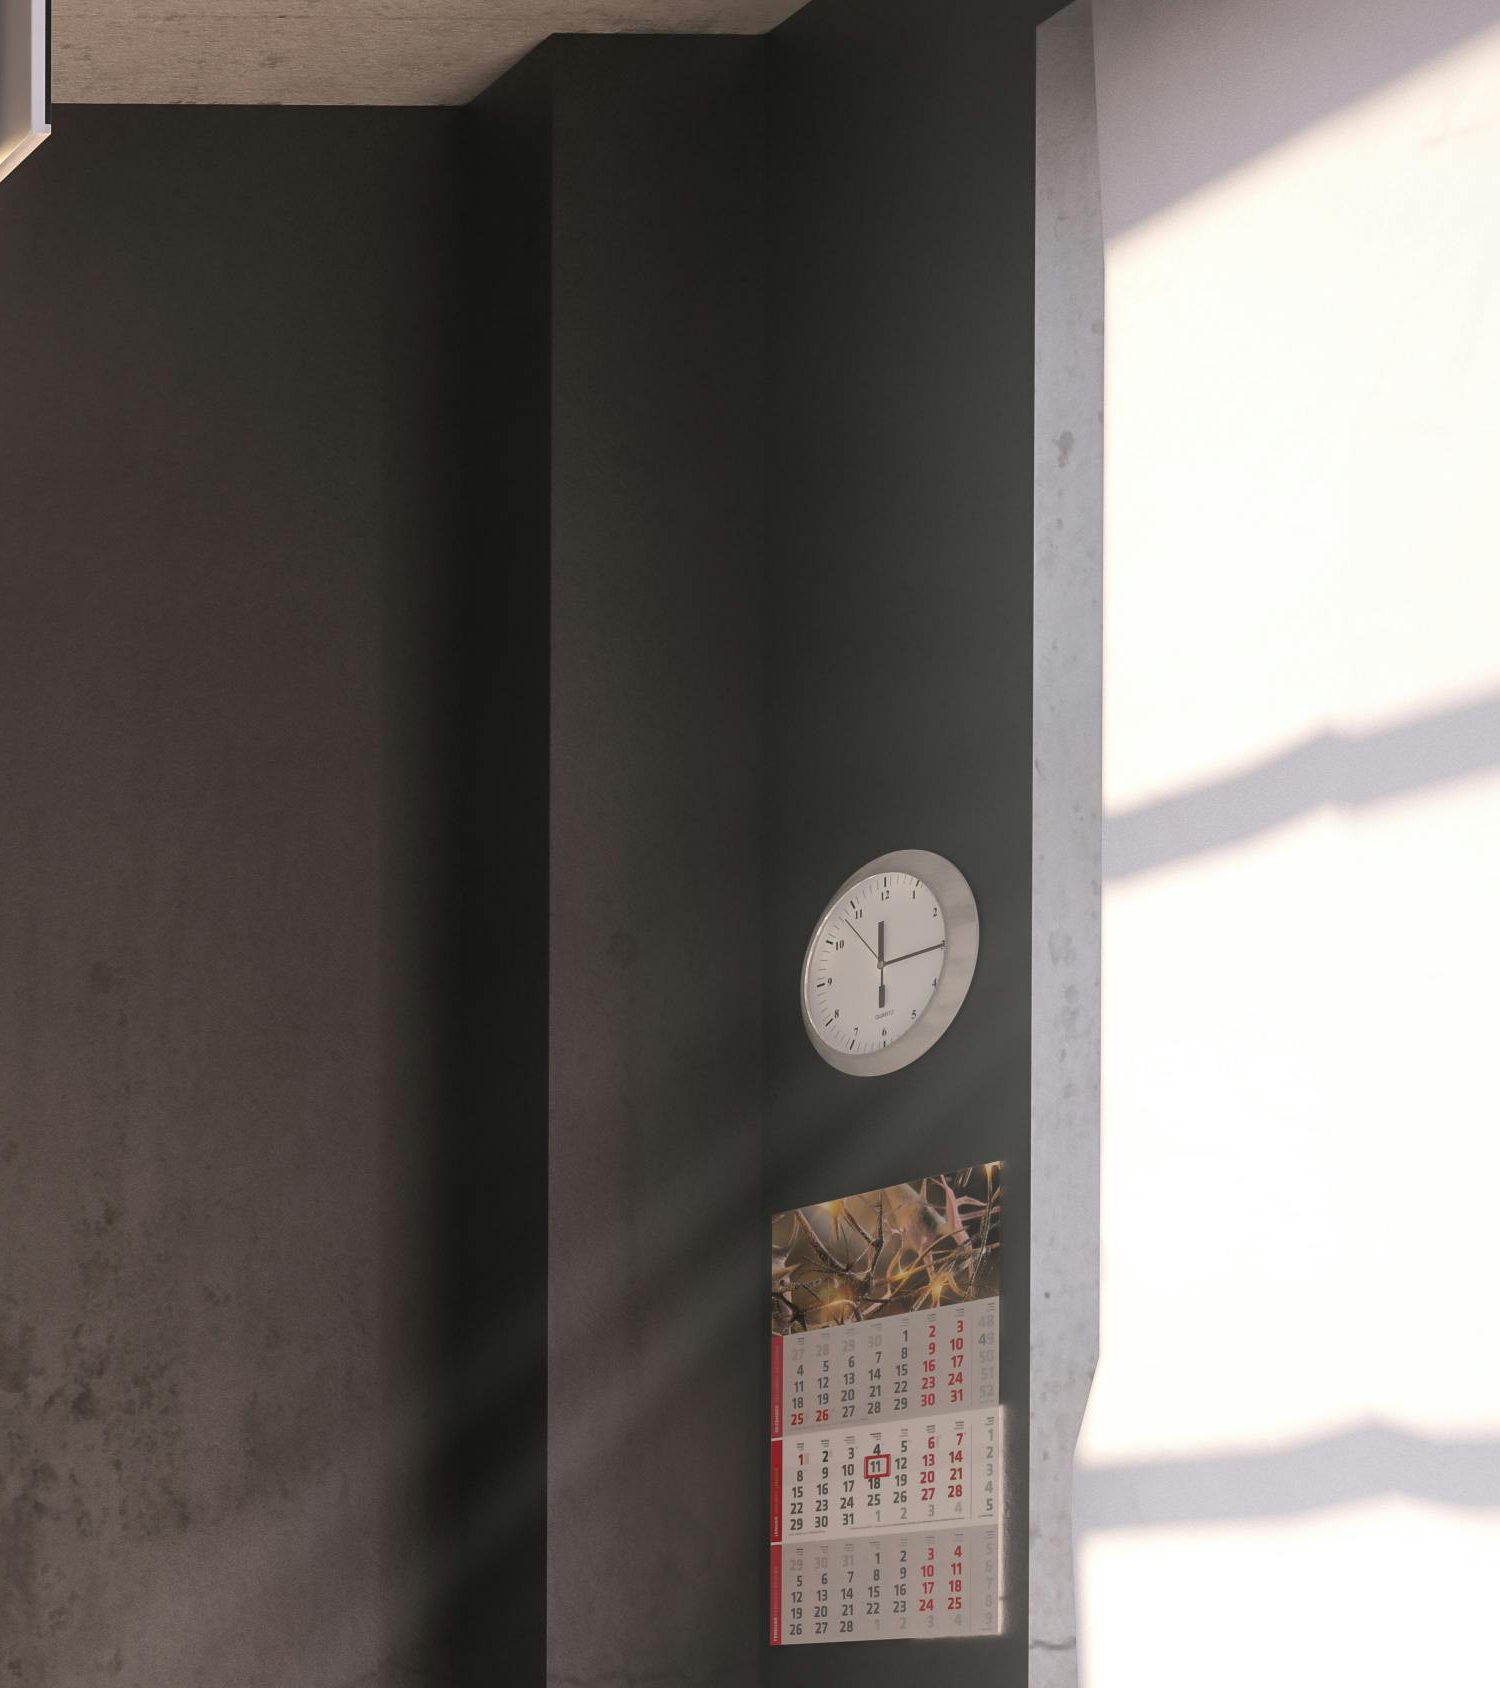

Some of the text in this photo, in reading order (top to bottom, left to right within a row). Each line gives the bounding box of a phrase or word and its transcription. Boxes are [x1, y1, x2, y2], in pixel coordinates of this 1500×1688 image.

[881, 889, 890, 901] 12
[855, 909, 862, 920] 11
[932, 907, 938, 918] 2
[836, 940, 845, 951] 10
[827, 977, 833, 986] 9
[834, 1009, 840, 1019] 8
[911, 1009, 917, 1020] 5
[853, 1027, 859, 1036] 7
[881, 1028, 887, 1037] 6
[903, 1329, 908, 1342] 1
[929, 1325, 936, 1338] 2
[957, 1320, 964, 1333] 3
[796, 1364, 804, 1376] 4
[823, 1360, 829, 1372] 5
[848, 1355, 855, 1368] 6
[875, 1351, 882, 1364] 7
[901, 1347, 908, 1359] 8
[928, 1342, 936, 1355] 9
[950, 1337, 963, 1351] 10
[793, 1380, 804, 1393] 11
[817, 1376, 829, 1389] 12
[843, 1372, 855, 1385] 13
[868, 1368, 881, 1381] 14
[895, 1364, 908, 1377] 15
[923, 1359, 936, 1372] 16
[951, 1354, 964, 1368] 17
[791, 1396, 804, 1409] 18
[817, 1393, 829, 1406] 19
[840, 1388, 855, 1402] 20
[869, 1385, 881, 1398] 21
[894, 1380, 908, 1394] 22
[921, 1376, 935, 1390] 23
[948, 1371, 963, 1386] 24
[791, 1413, 804, 1426] 25
[816, 1409, 829, 1422] 26
[842, 1405, 855, 1418] 27
[867, 1401, 881, 1415] 28
[894, 1397, 908, 1411] 29
[921, 1393, 935, 1407] 30
[950, 1389, 963, 1403] 31
[798, 1428, 994, 1466] 1 2 3 4 5 6 7 1
[797, 1446, 993, 1482] 8 9 10 11 12 13 14 2
[792, 1463, 993, 1498] 15 16 17 18 19 20 21 3
[790, 1480, 994, 1515] 22 23 24 25 26 27 28 4
[790, 1518, 803, 1531] 29
[815, 1515, 828, 1528] 30
[842, 1513, 854, 1526] 31
[875, 1510, 880, 1522] 1
[900, 1507, 907, 1520] 2
[928, 1504, 935, 1517] 3
[954, 1501, 963, 1513] 4
[986, 1498, 993, 1511] 5
[875, 1552, 880, 1565] 1
[900, 1550, 907, 1562] 2
[928, 1547, 934, 1561] 3
[954, 1545, 962, 1558] 4
[797, 1575, 803, 1587] 5
[821, 1573, 828, 1585] 6
[847, 1571, 854, 1583] 7
[873, 1569, 880, 1581] 8
[900, 1566, 907, 1579] 9
[920, 1564, 934, 1577] 10
[951, 1562, 962, 1576] 11
[791, 1591, 803, 1603] 12
[816, 1589, 828, 1602] 13
[841, 1587, 854, 1600] 14
[868, 1585, 880, 1598] 15
[894, 1583, 907, 1596] 16
[922, 1581, 935, 1594] 17
[948, 1579, 962, 1592] 18
[790, 1607, 802, 1619] 19
[813, 1605, 828, 1618] 20
[842, 1604, 853, 1616] 21
[866, 1602, 880, 1615] 22
[893, 1600, 906, 1613] 23
[919, 1599, 934, 1612] 24
[947, 1597, 962, 1610] 25
[789, 1623, 803, 1636] 26
[815, 1622, 828, 1634] 27
[839, 1620, 853, 1633] 28
